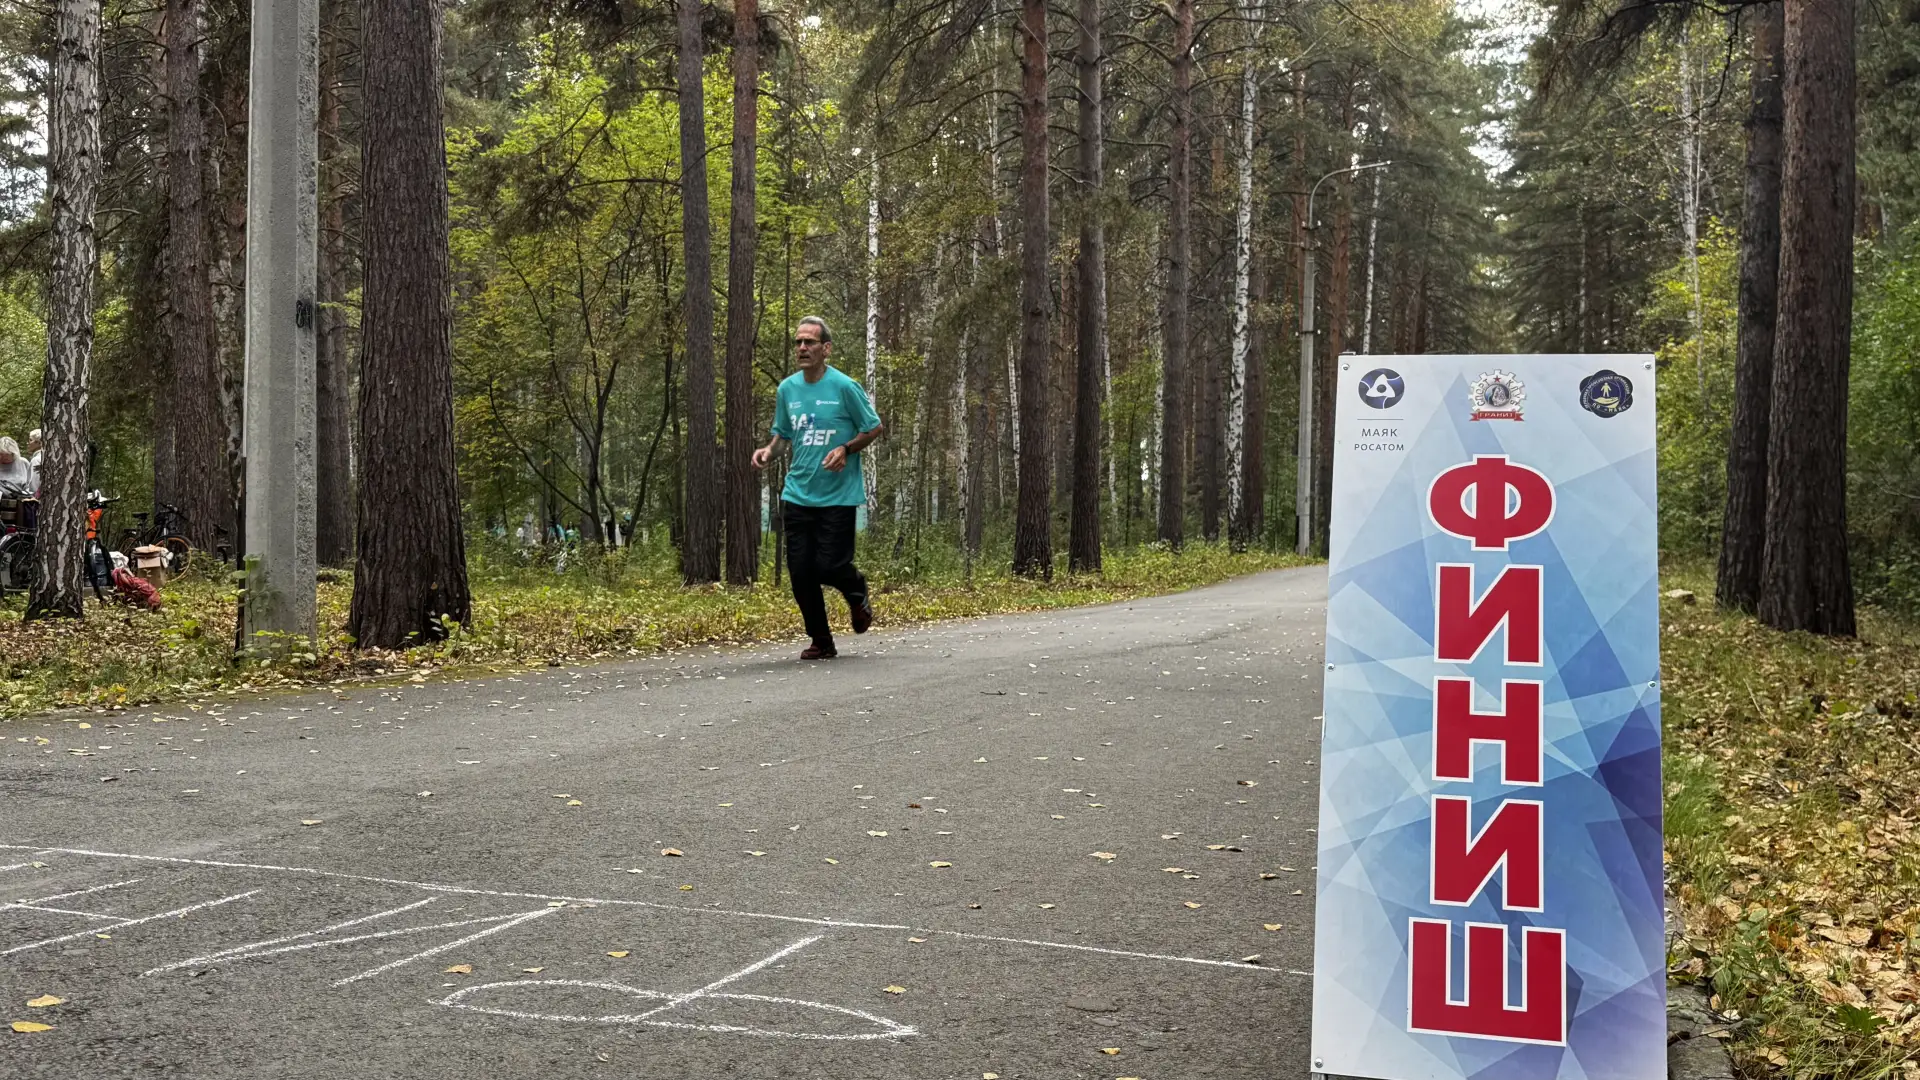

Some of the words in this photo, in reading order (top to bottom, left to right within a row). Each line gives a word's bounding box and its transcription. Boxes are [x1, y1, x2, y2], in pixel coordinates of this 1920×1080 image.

[1474, 378, 1491, 407] СПОРТ
[1505, 379, 1522, 406] КЛУБ
[802, 429, 837, 446] БЕГ
[1361, 428, 1398, 437] МАЯК
[1354, 443, 1405, 451] РОСАТОМ
[1407, 453, 1567, 1047] ФИНИШ
